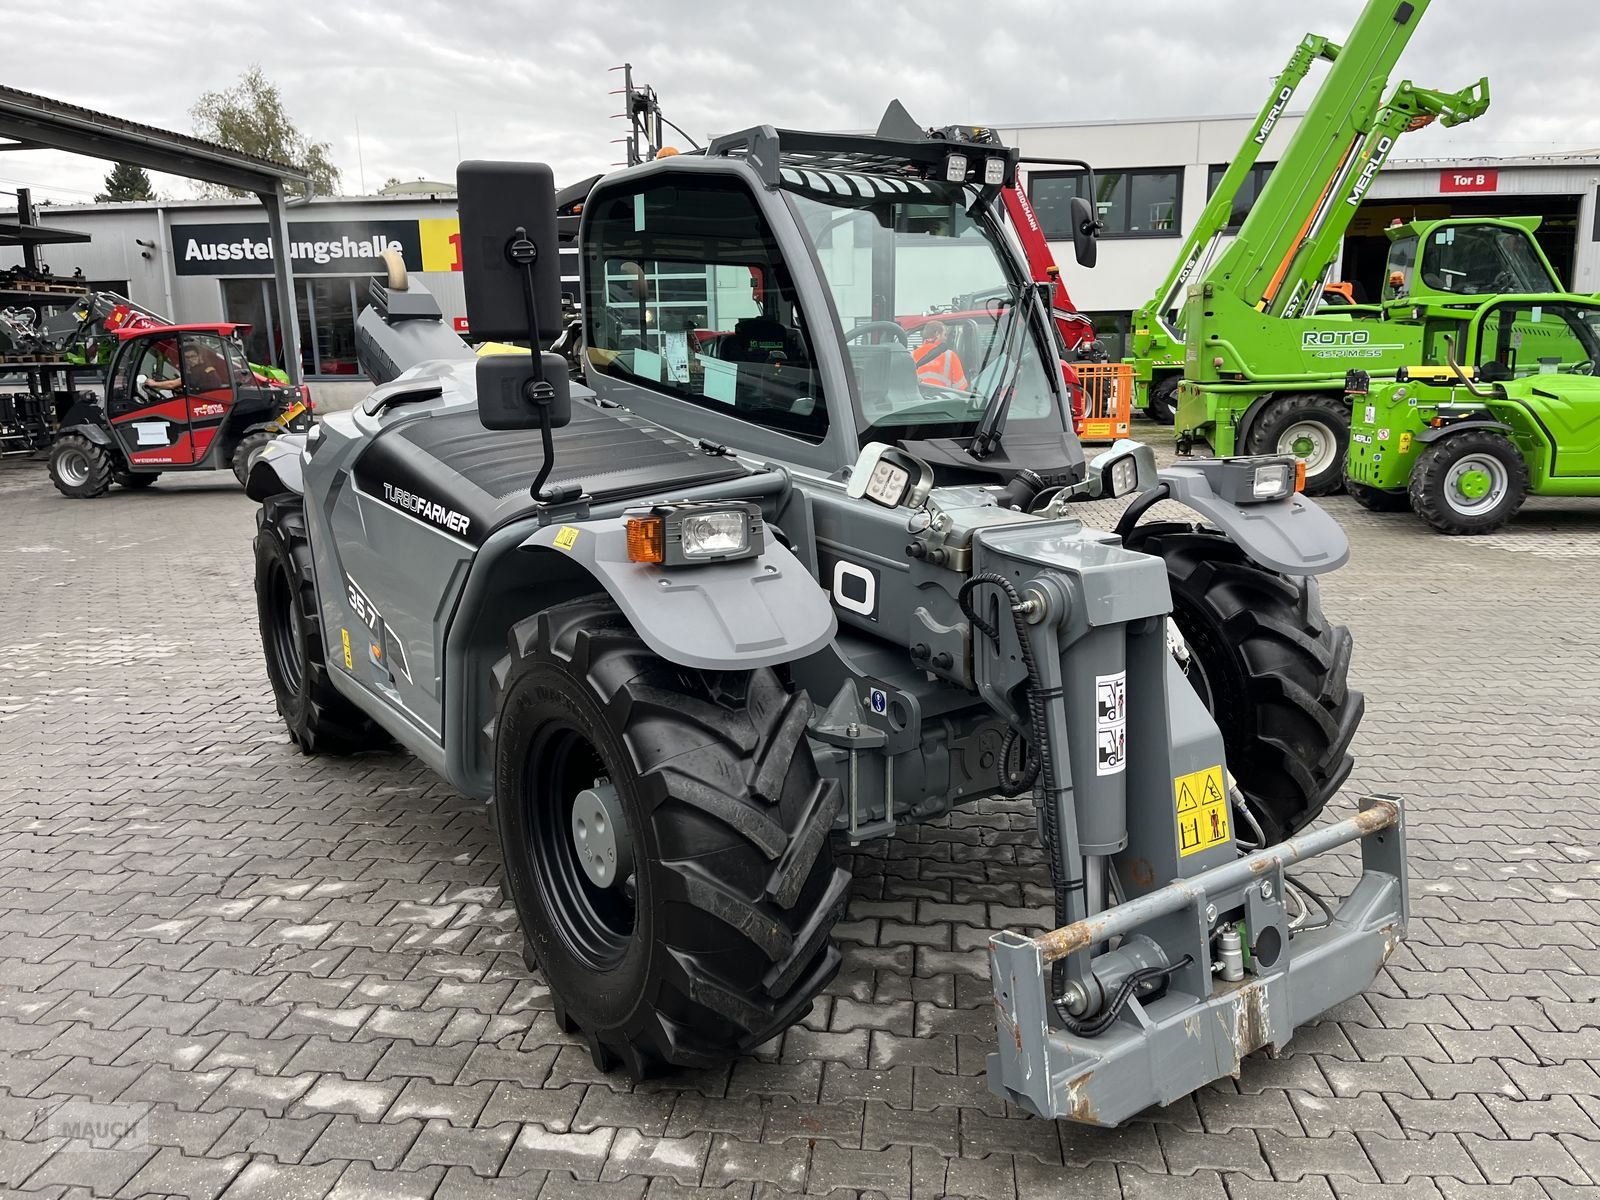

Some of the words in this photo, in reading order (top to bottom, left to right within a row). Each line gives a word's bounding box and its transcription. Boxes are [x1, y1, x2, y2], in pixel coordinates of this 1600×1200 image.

[1254, 87, 1291, 144] MERLO
[1346, 136, 1391, 206] MERLO
[1454, 175, 1473, 186] Tor
[1476, 174, 1485, 185] B
[185, 236, 403, 263] Ausstelungshalle
[1303, 331, 1370, 346] ROTO
[383, 482, 471, 536] TURBOFARMER
[348, 585, 376, 630] 35.7
